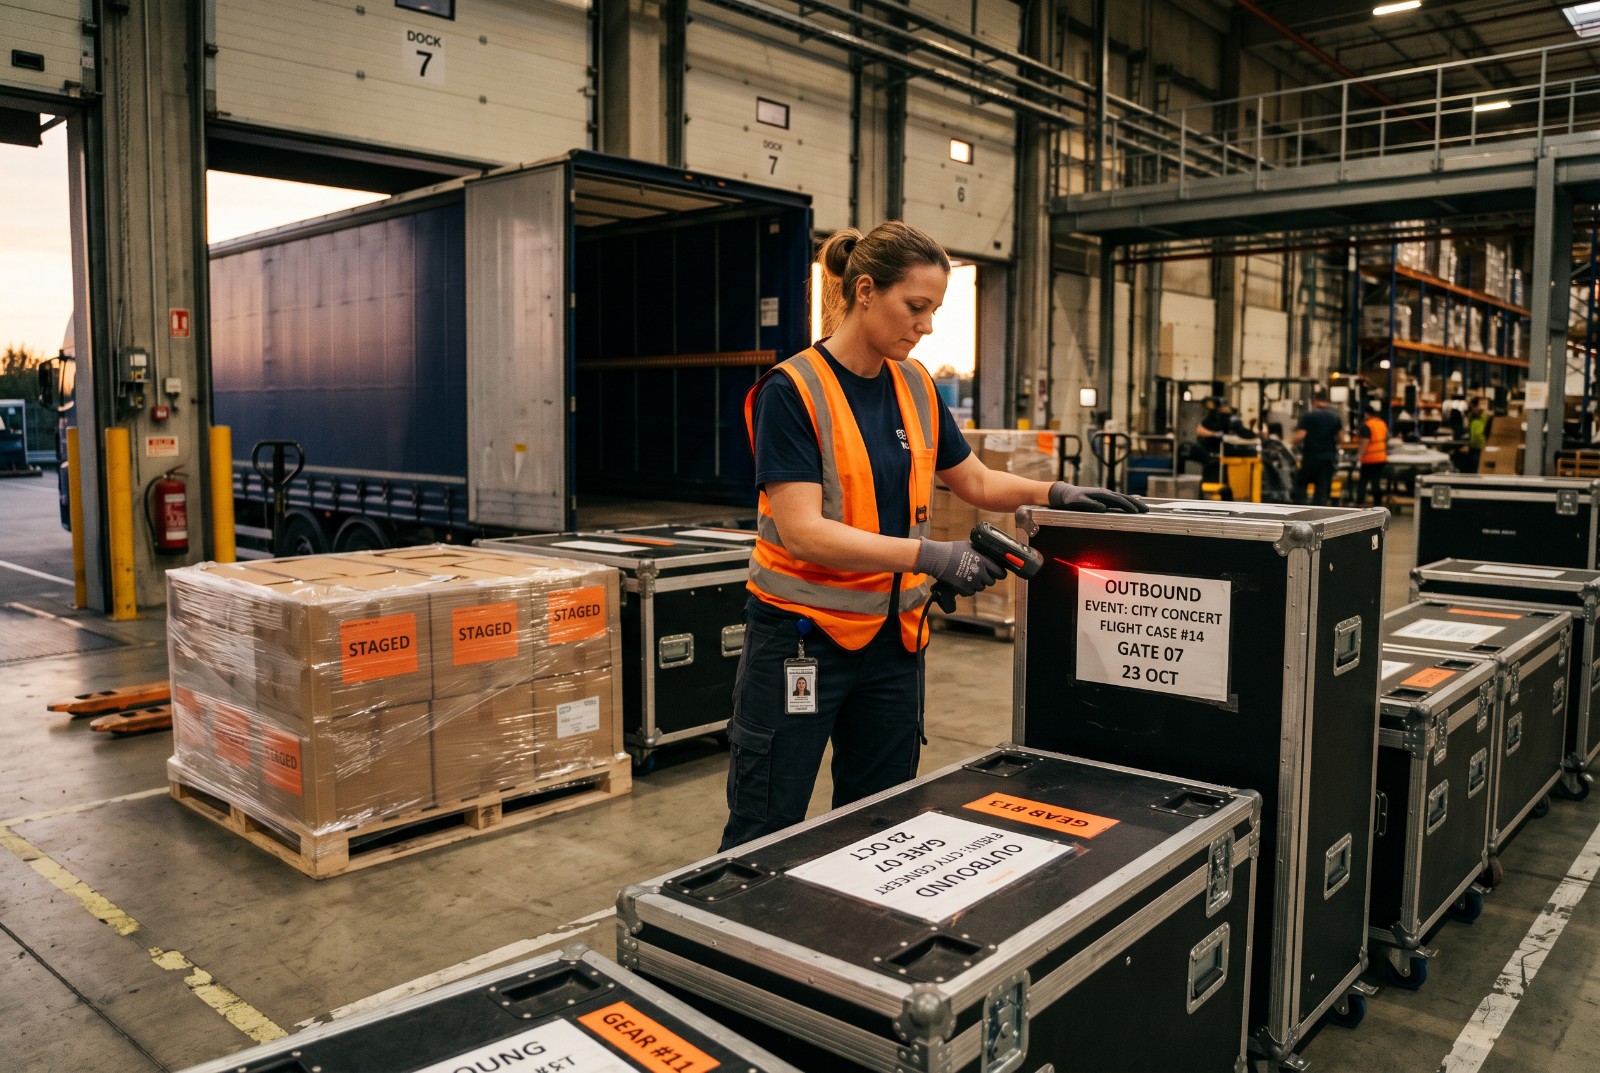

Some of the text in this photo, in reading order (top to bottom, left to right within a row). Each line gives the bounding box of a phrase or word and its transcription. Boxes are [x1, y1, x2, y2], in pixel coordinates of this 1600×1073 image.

[407, 30, 442, 48] DOCK
[416, 50, 433, 77] 7
[769, 155, 778, 175] 7
[957, 186, 965, 202] 6
[1105, 580, 1202, 602] OUTBOUND
[553, 604, 601, 622] STAGED
[1085, 600, 1223, 625] EVENT: CITY CONCERT
[458, 621, 513, 641] STAGED
[1100, 620, 1205, 643] FLIGHT CASE #14
[349, 635, 410, 657] STAGED
[1117, 641, 1184, 663] GATE 07
[1122, 665, 1179, 686] 23 OCT
[849, 831, 915, 861] 23 OCT
[874, 859, 903, 873] 07
[916, 844, 1023, 897] OUTBOUND
[602, 1012, 695, 1073] GEAR #11
